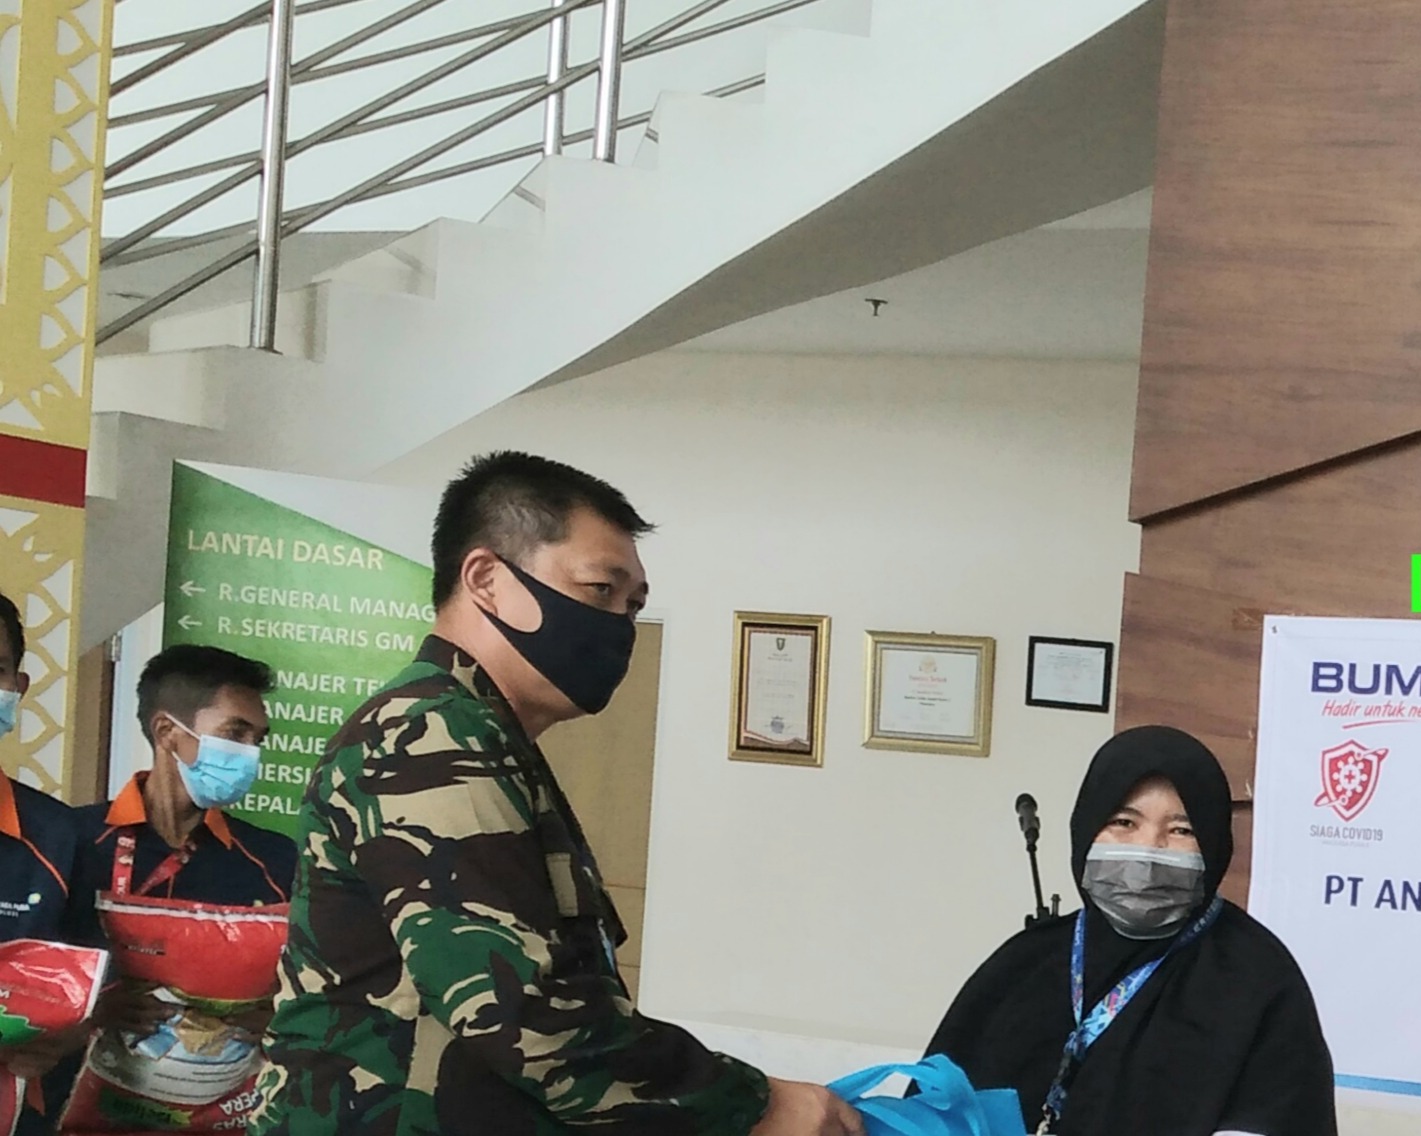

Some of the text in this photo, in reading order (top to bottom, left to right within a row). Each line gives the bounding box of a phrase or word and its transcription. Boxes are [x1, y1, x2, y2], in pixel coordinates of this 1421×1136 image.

[188, 529, 384, 570] LANTAI DASAR
[218, 583, 436, 623] R.GENERAL MANAG
[375, 632, 414, 652] GM
[272, 670, 346, 695] NAJER
[1321, 699, 1361, 717] Hadir
[1364, 700, 1404, 717] untuk
[259, 733, 326, 756] ANAJE
[1310, 825, 1340, 839] SIAGA
[1324, 875, 1363, 907] PT
